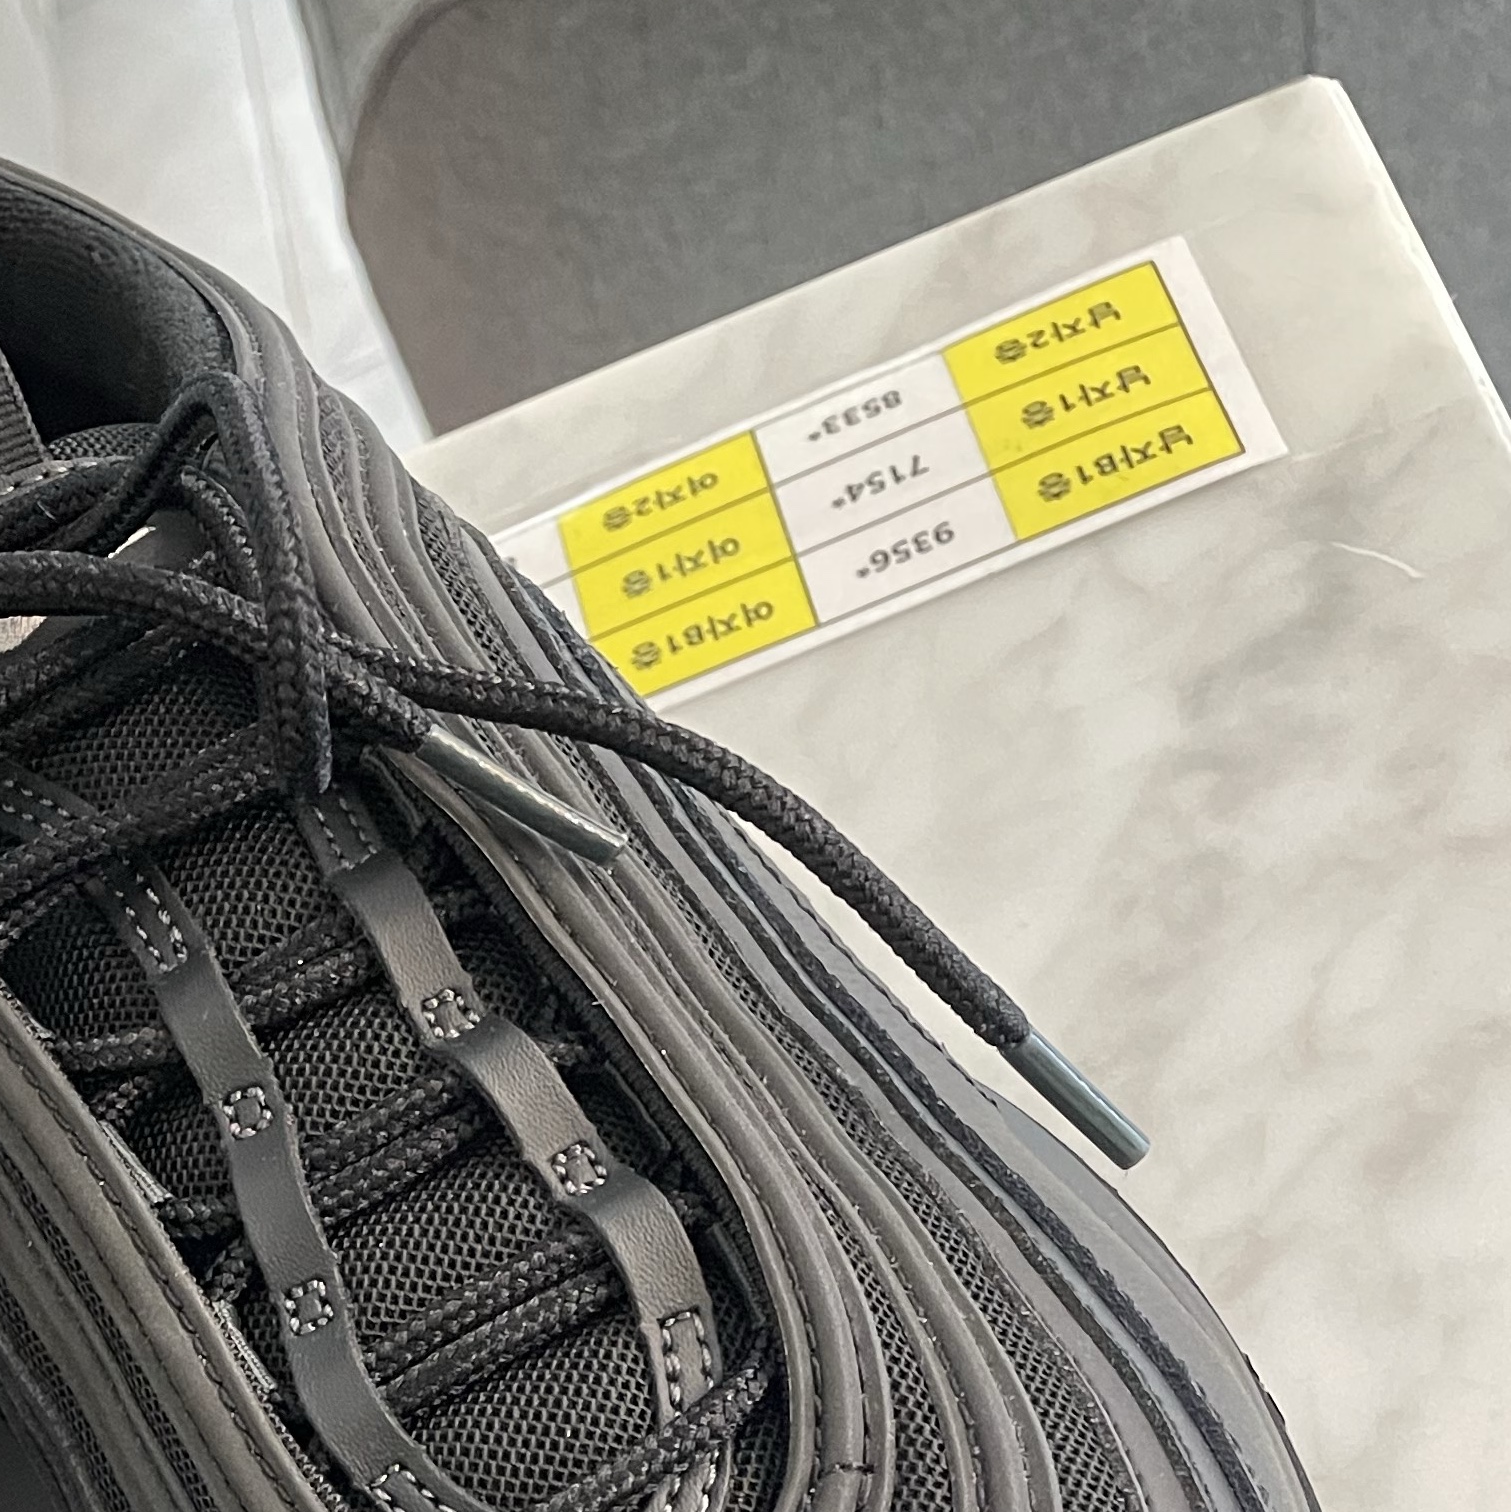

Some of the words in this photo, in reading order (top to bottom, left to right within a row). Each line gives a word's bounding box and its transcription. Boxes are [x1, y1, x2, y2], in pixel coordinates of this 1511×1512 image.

[995, 301, 1122, 365] 남자2층
[1022, 364, 1151, 429] 남자1층
[1037, 425, 1194, 502] 남자B1층
[602, 470, 718, 532] 여자2층
[621, 537, 740, 599] 여자1층
[631, 601, 774, 671] 여자B1층
